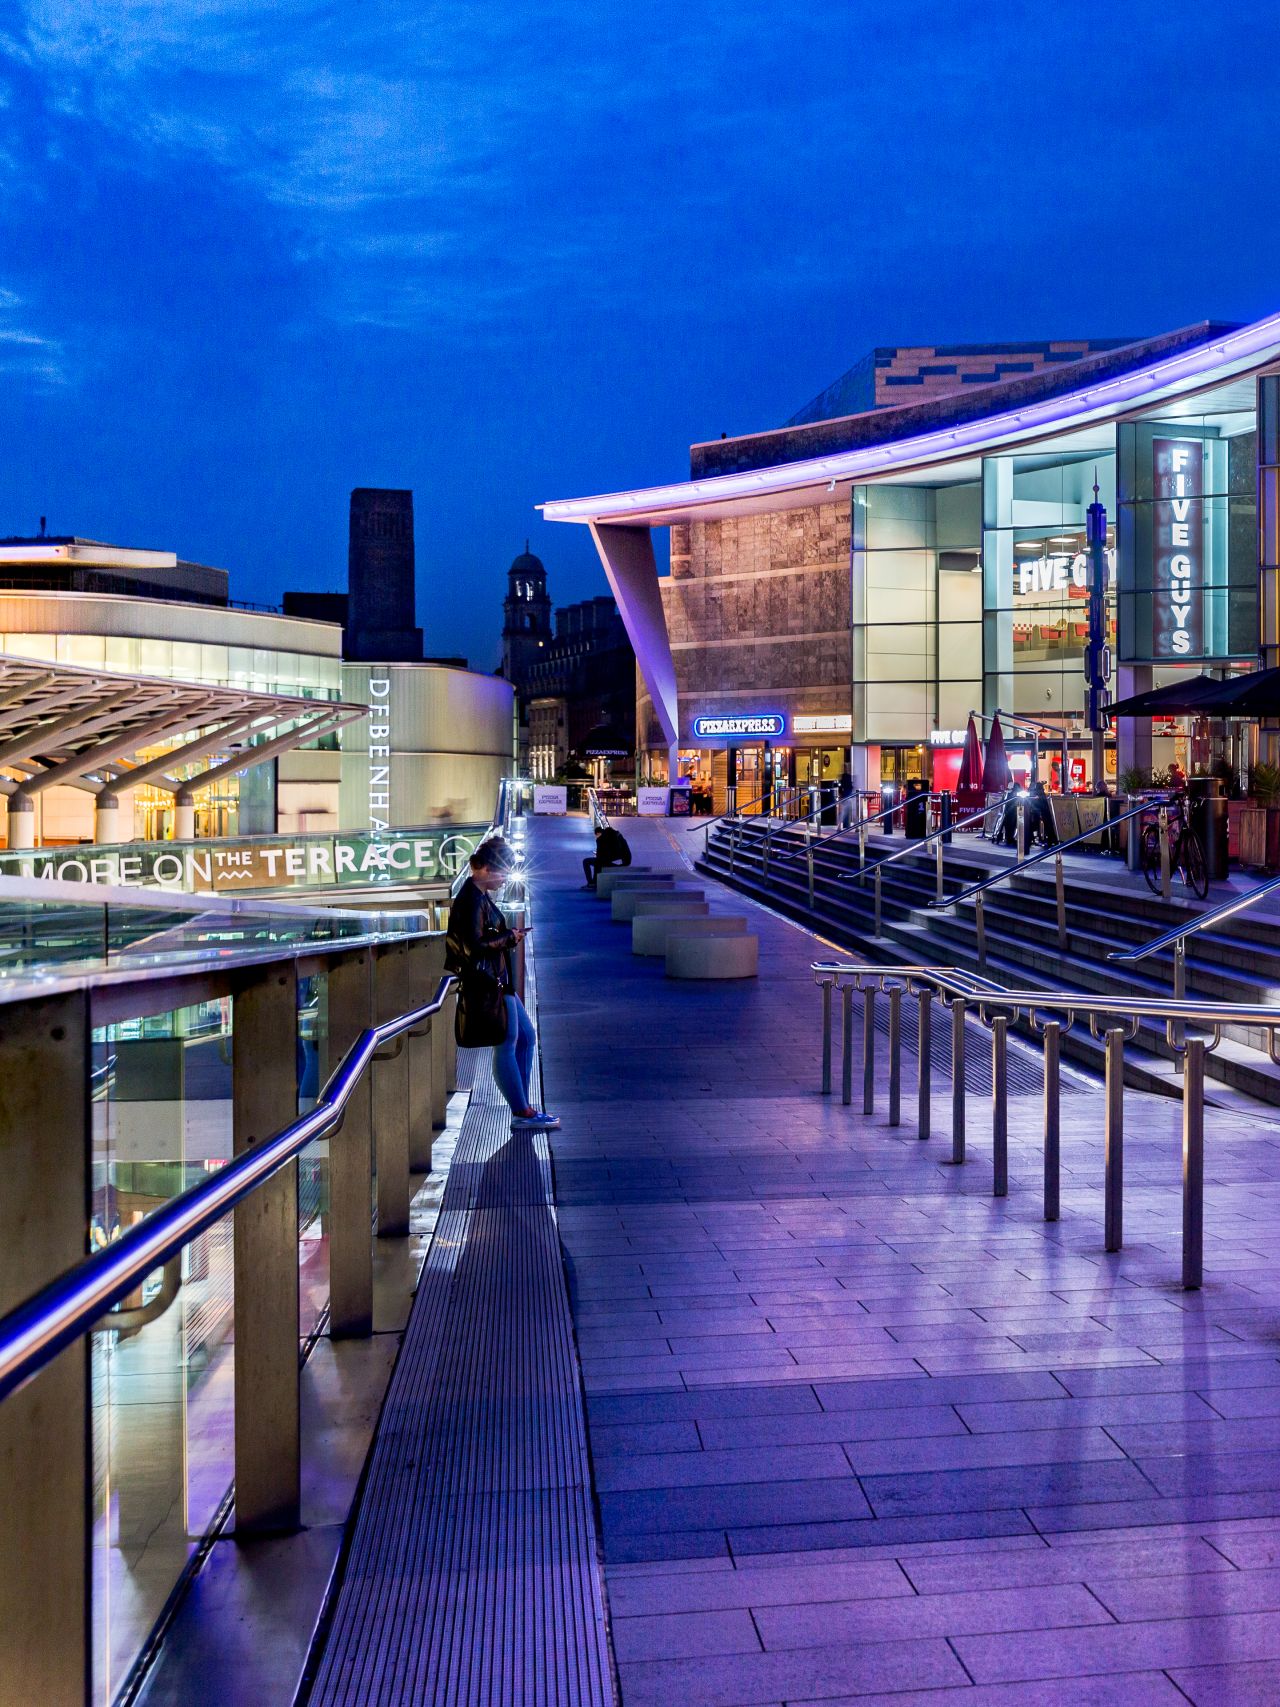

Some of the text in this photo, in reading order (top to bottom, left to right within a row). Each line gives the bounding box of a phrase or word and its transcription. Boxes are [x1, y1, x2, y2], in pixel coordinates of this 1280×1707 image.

[1170, 449, 1191, 654] FIVE GUYS
[1020, 555, 1069, 595] FIVE
[152, 852, 213, 885] ON
[215, 851, 253, 867] THE
[259, 840, 434, 878] TERRACE
